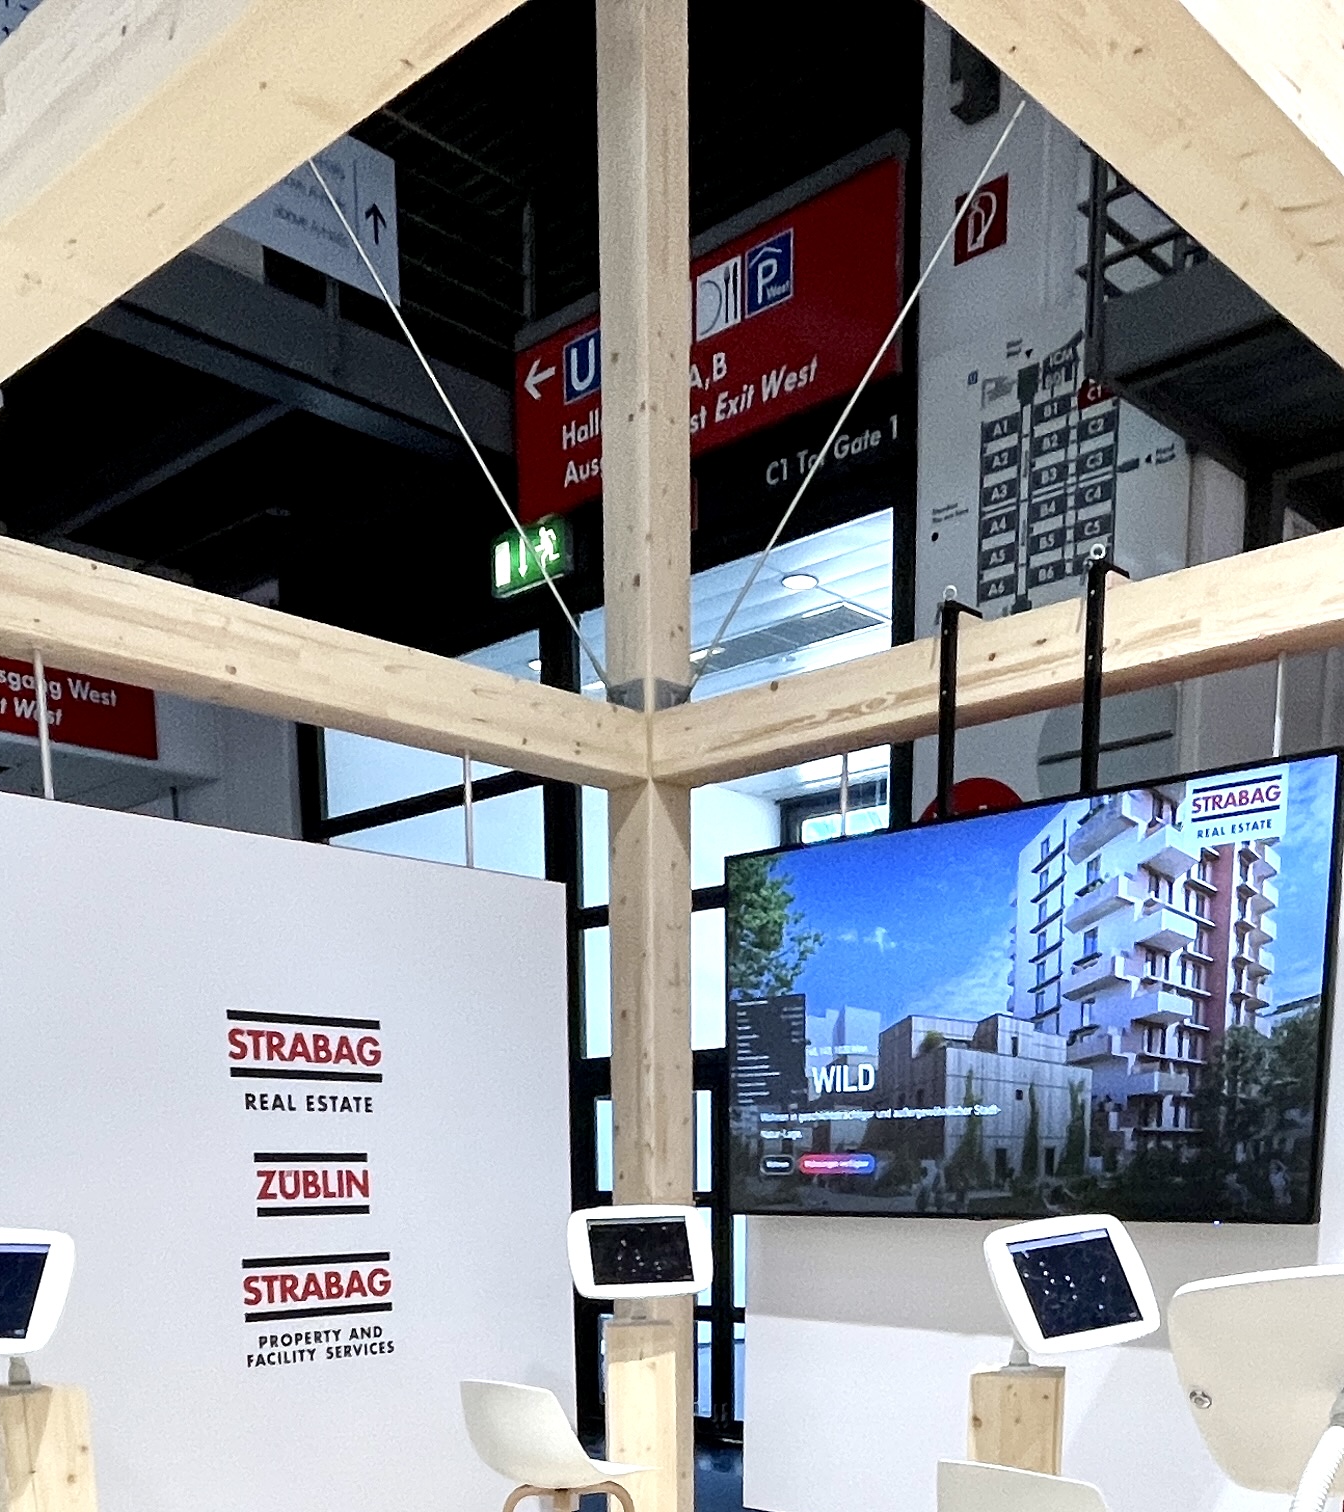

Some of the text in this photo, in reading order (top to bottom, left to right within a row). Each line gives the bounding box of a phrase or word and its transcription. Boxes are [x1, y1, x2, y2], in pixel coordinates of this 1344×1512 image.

[757, 258, 778, 304] P
[570, 337, 595, 391] U
[1087, 384, 1102, 401] C1
[562, 408, 601, 450] Hall
[564, 458, 602, 488] Aus
[715, 384, 754, 423] Exit
[761, 353, 818, 403] West
[993, 420, 1008, 437] A1
[1088, 419, 1104, 434] C2
[766, 414, 897, 485] C1 To Gate 1
[992, 453, 1009, 468] A2
[1086, 452, 1103, 468] C3
[1041, 467, 1057, 484] B3
[991, 485, 1007, 501] A3
[1085, 486, 1102, 502] C4
[1040, 501, 1056, 517] B4
[989, 517, 1006, 534] A4
[1084, 520, 1100, 536] C5
[1039, 533, 1055, 549] B5
[989, 550, 1005, 565] A5
[1038, 566, 1054, 582] B6
[988, 581, 1005, 597] A6
[67, 677, 117, 707] West
[1191, 785, 1281, 814] STRABAG
[1197, 819, 1272, 838] REAL ESTATE
[227, 1028, 381, 1067] STRABAG
[812, 1063, 875, 1093] WILD
[244, 1093, 373, 1113] REAL ESTATE
[256, 1169, 369, 1200] ZÜBLIN
[243, 1268, 392, 1306] STRABAG
[258, 1325, 383, 1348] PROPERTY AND
[247, 1341, 395, 1368] FACILITY SERVICES
